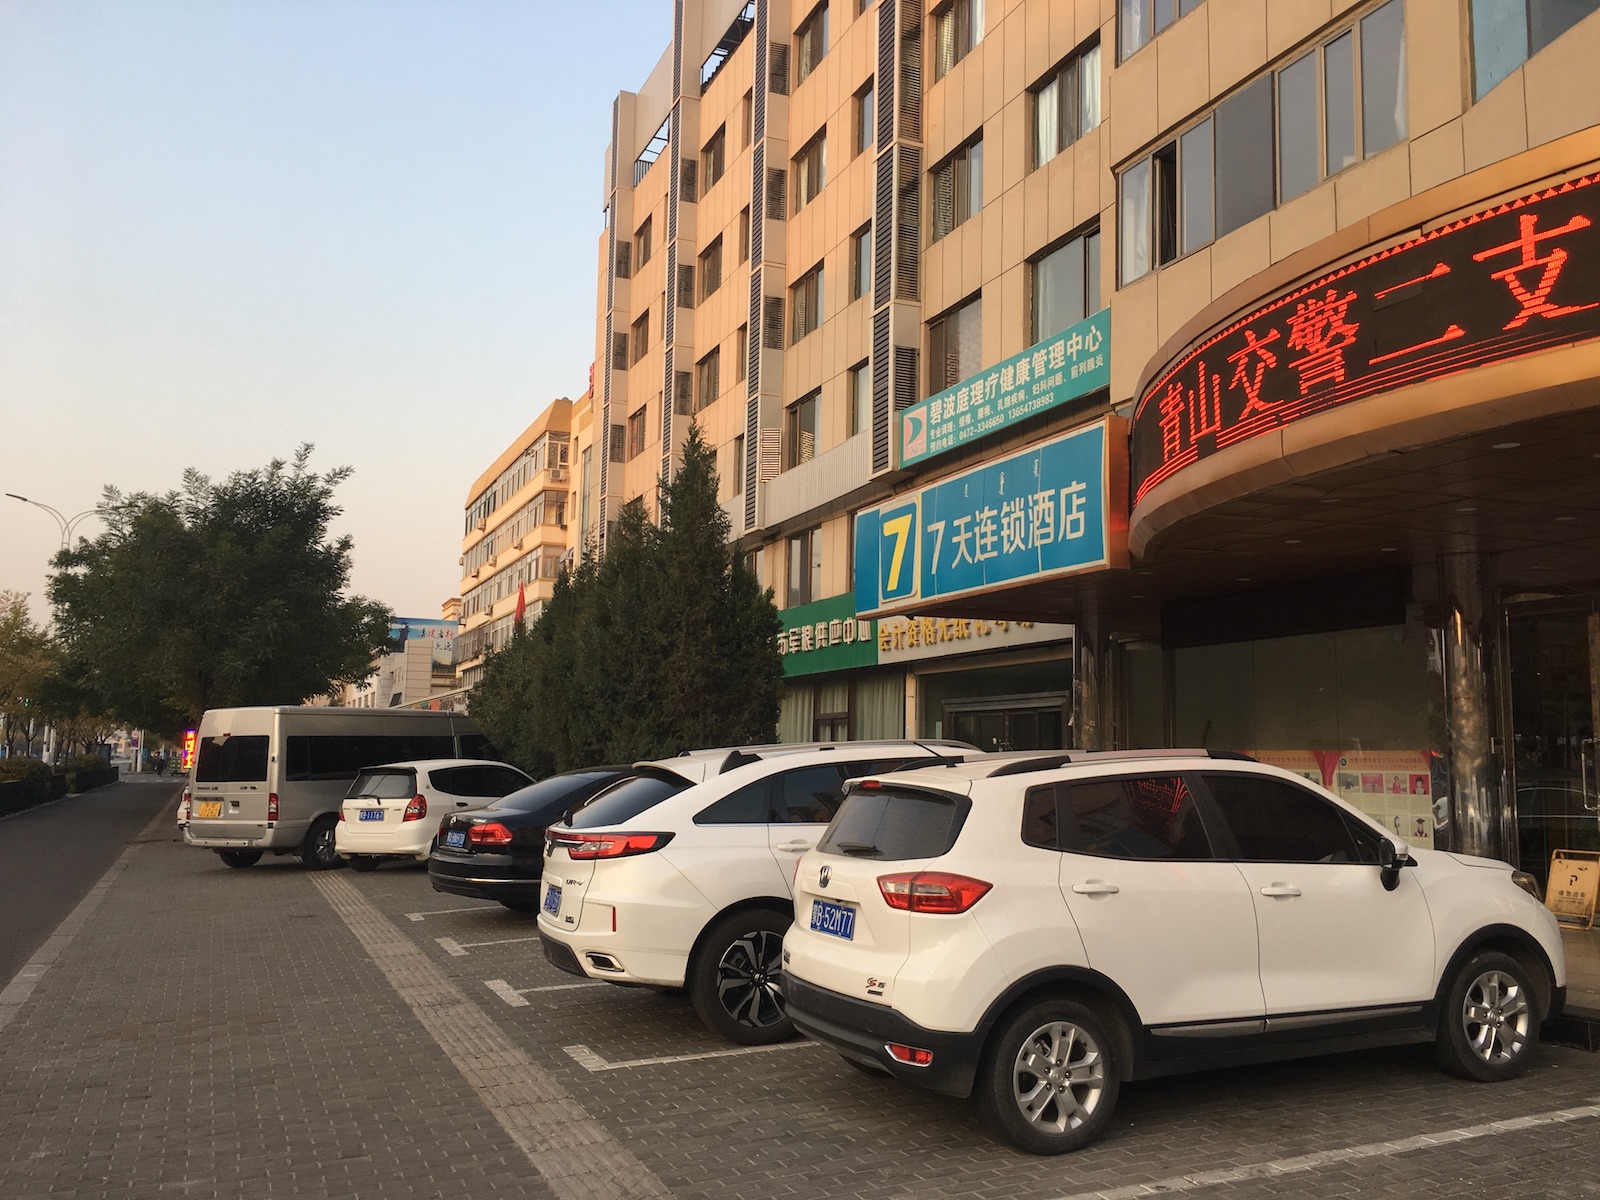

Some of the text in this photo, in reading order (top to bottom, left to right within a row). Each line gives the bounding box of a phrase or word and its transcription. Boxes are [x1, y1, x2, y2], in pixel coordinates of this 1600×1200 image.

[930, 325, 1103, 425] 碧波庭理疗健康管理中心
[1158, 213, 1599, 462] 青山交警二支
[883, 513, 913, 592] 7
[927, 480, 1087, 576] 7天连锁酒店
